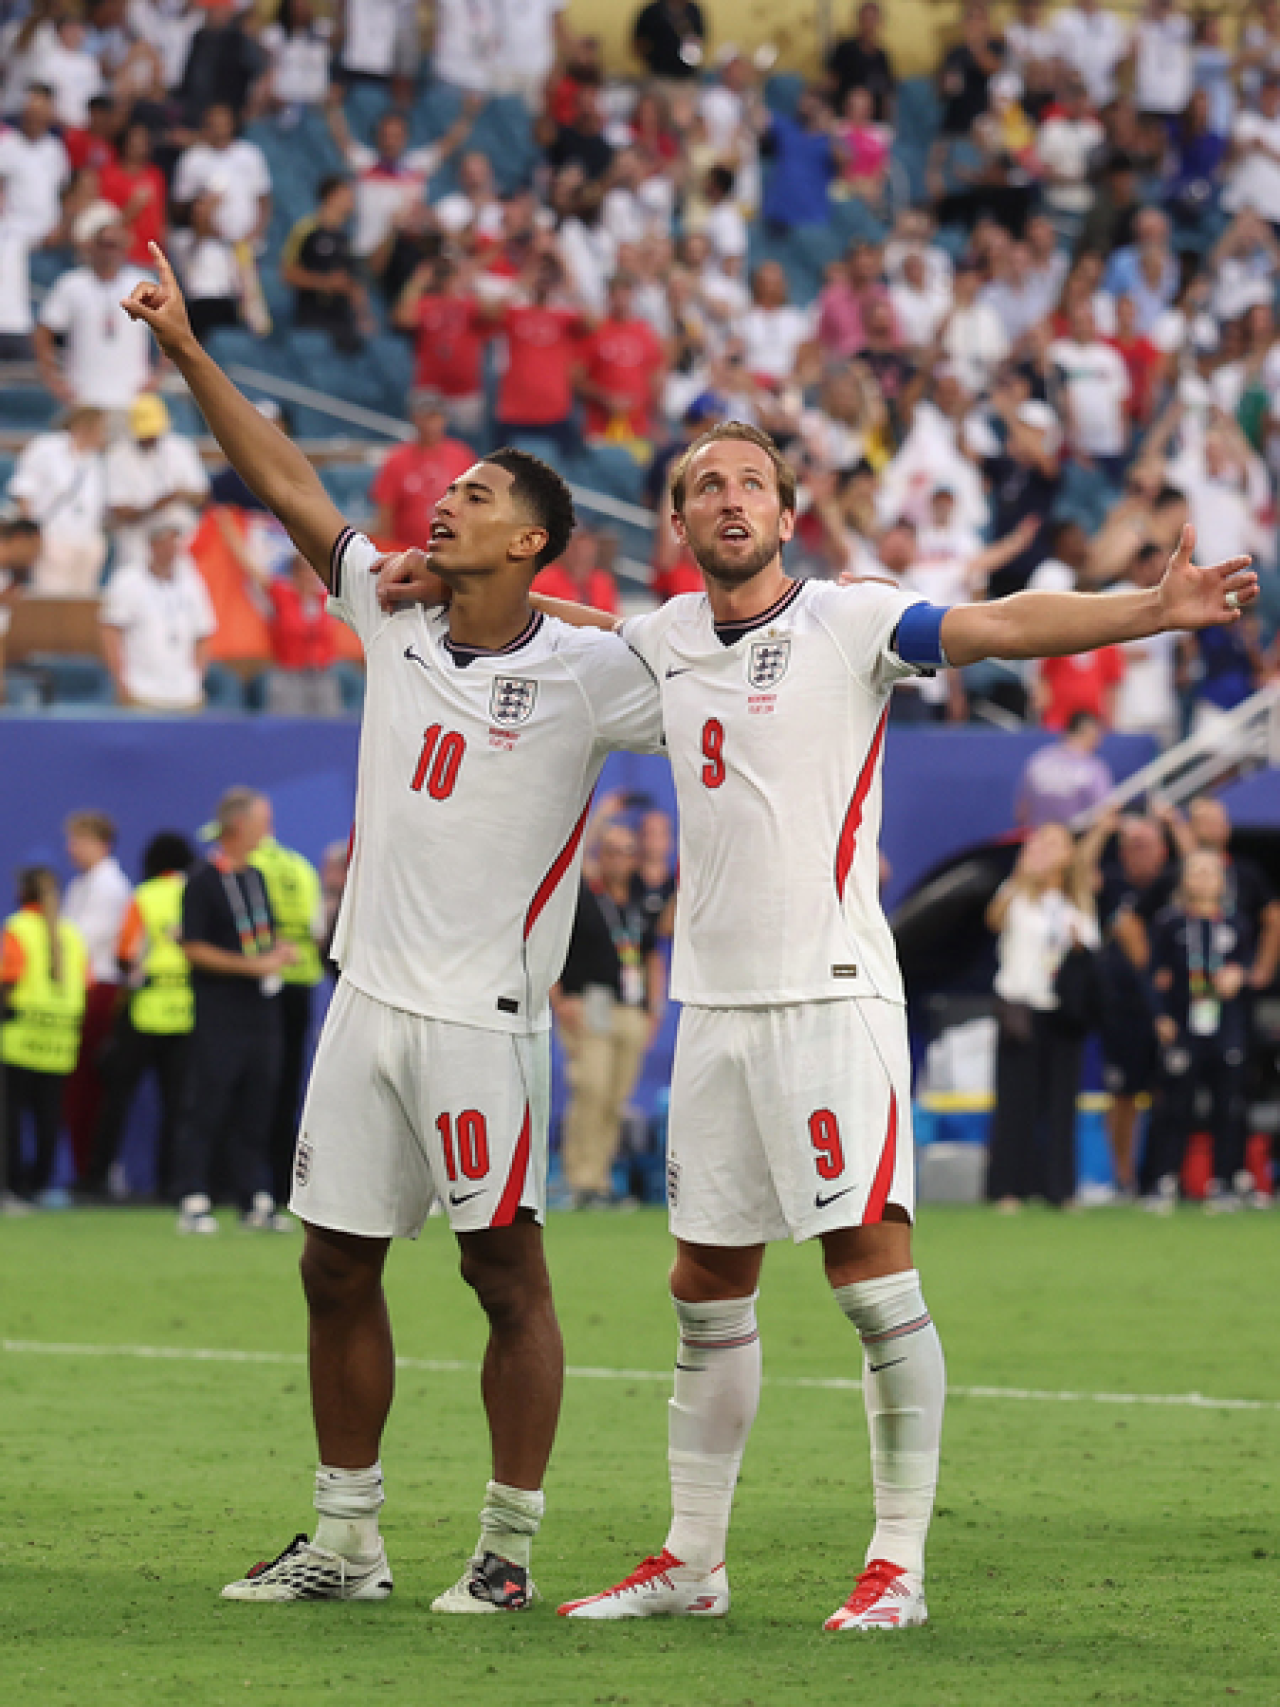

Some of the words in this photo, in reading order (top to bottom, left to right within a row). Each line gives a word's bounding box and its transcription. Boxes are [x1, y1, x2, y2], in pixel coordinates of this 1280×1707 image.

[411, 723, 466, 800] 10
[702, 717, 726, 789] 9
[435, 1108, 490, 1181] 10
[807, 1107, 845, 1181] 9
